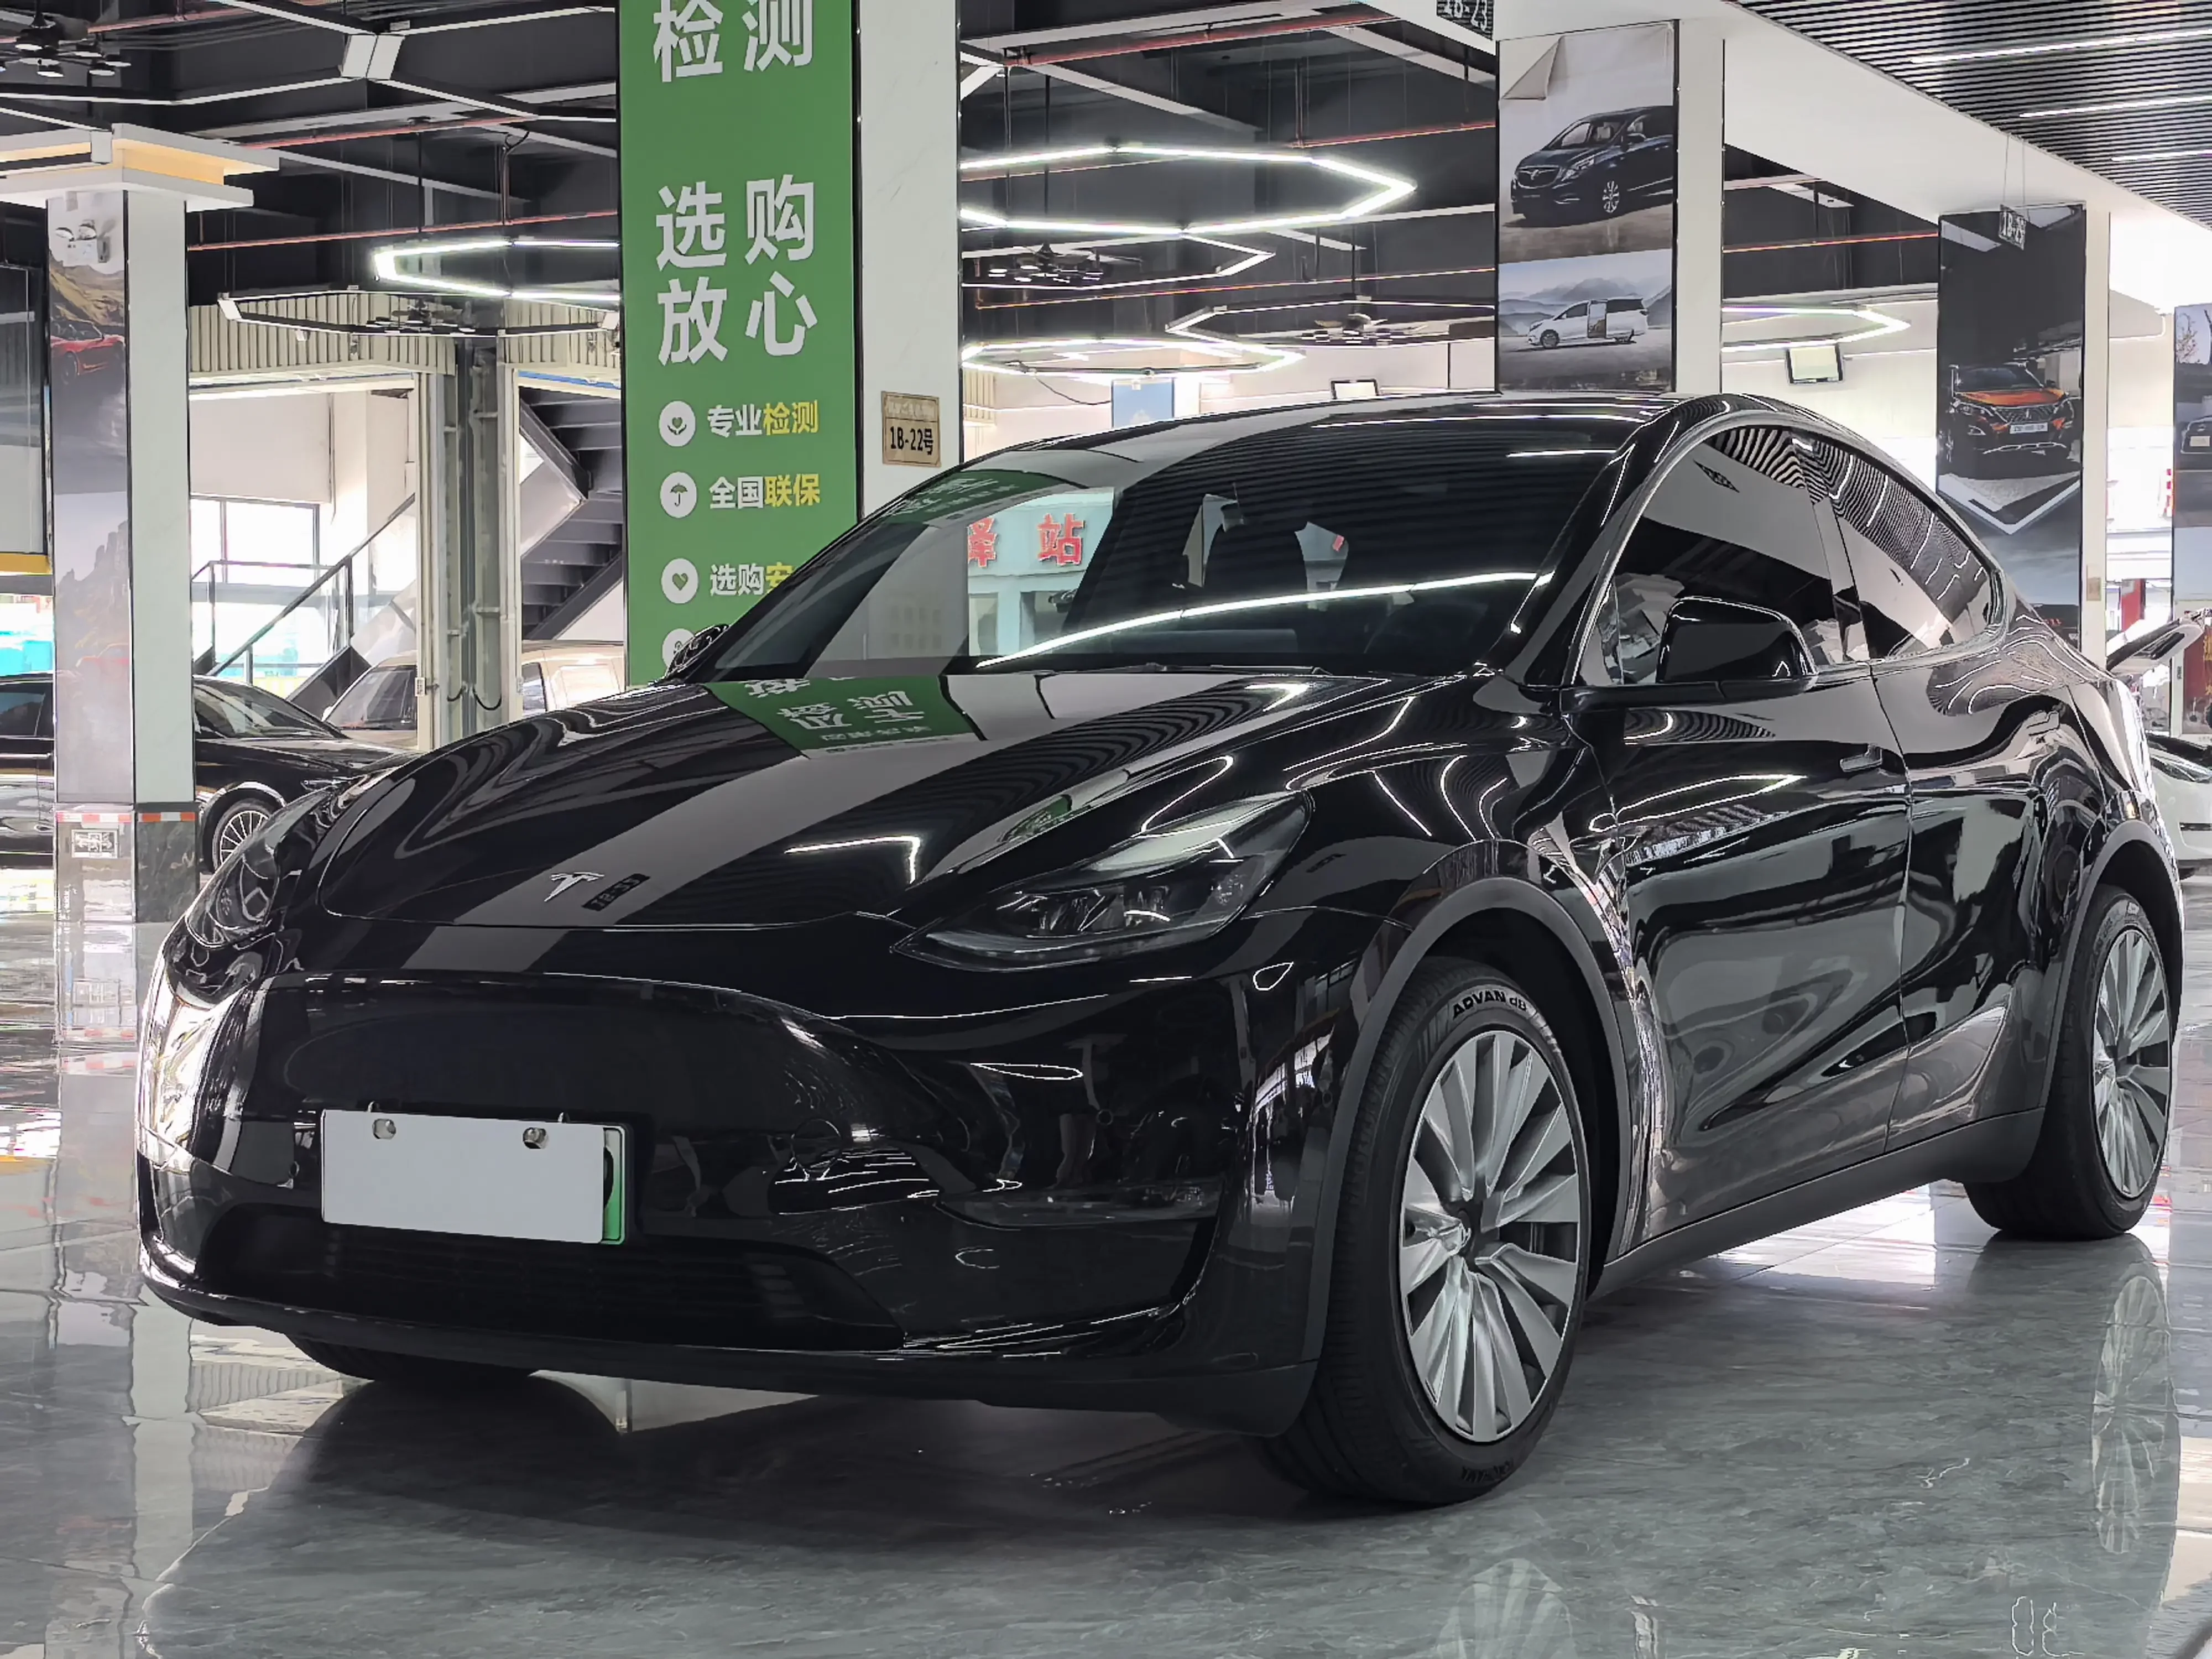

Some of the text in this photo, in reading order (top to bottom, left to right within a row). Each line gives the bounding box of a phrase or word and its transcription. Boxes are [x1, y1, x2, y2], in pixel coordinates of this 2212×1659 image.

[653, 0, 813, 82] 检测
[656, 174, 815, 271] 选购
[657, 271, 817, 366] 放心
[707, 400, 818, 437] 专业检测
[709, 474, 821, 509] 全国联保
[1453, 990, 1506, 1021] ADVAN
